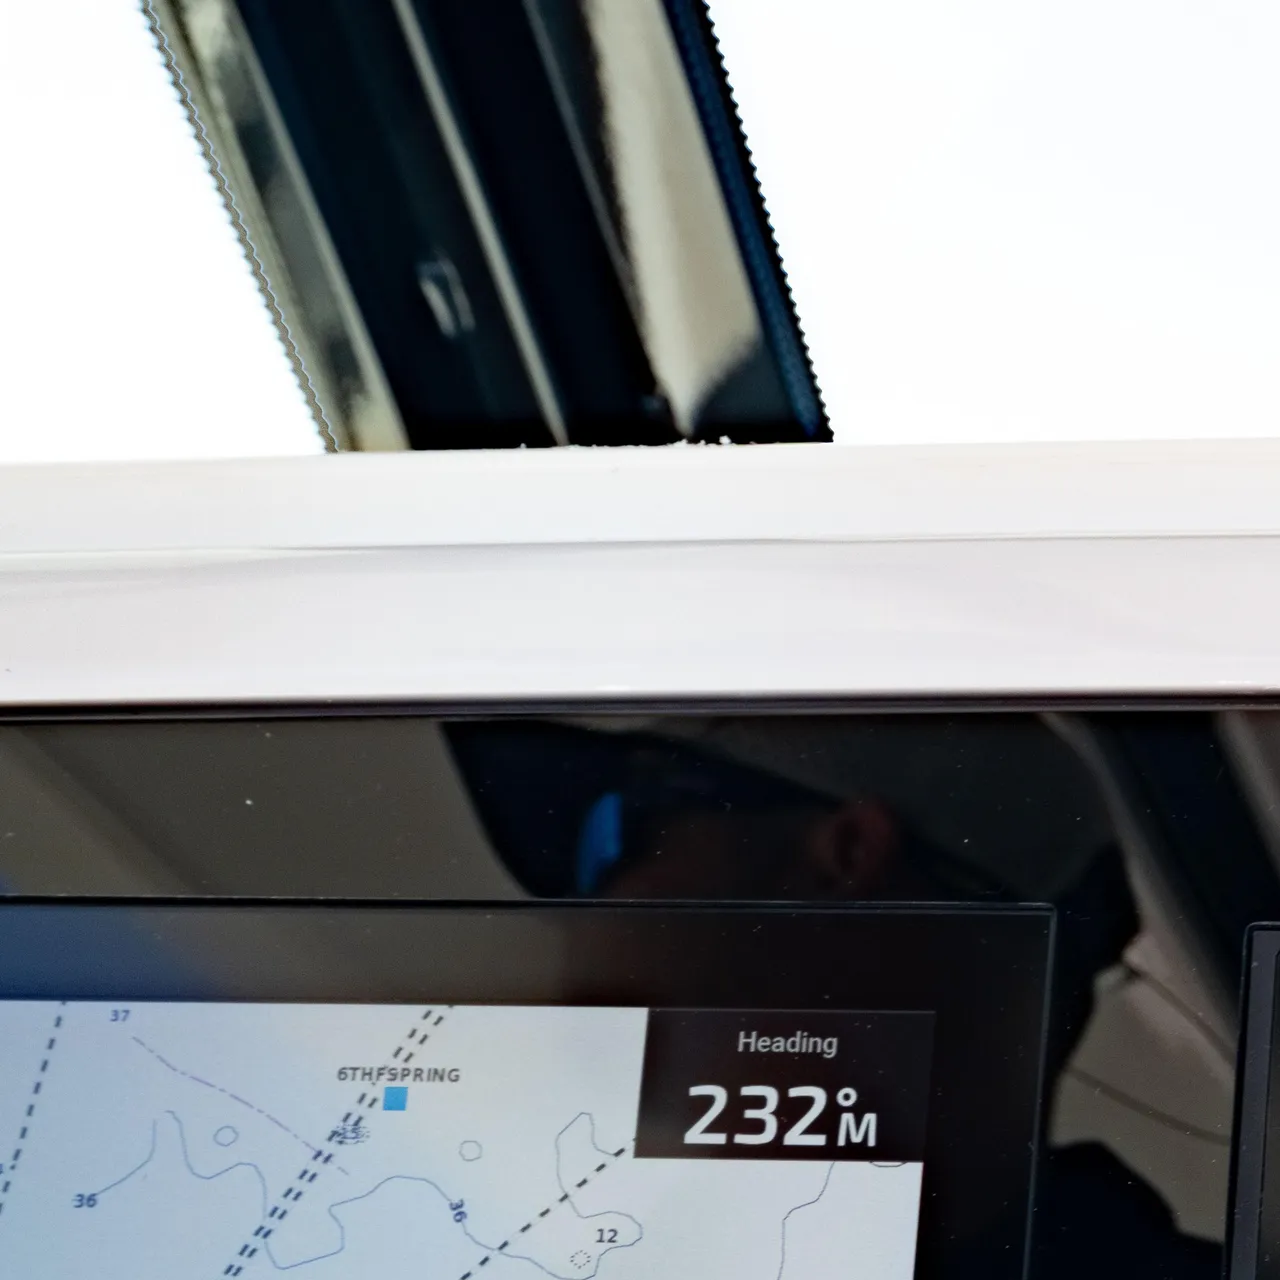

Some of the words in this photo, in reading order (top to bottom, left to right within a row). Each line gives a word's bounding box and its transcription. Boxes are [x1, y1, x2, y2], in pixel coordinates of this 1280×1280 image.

[110, 1010, 130, 1022] 37
[737, 1031, 838, 1058] Heading
[73, 1193, 97, 1208] 36
[449, 1199, 467, 1223] 36
[595, 1229, 618, 1244] 12
